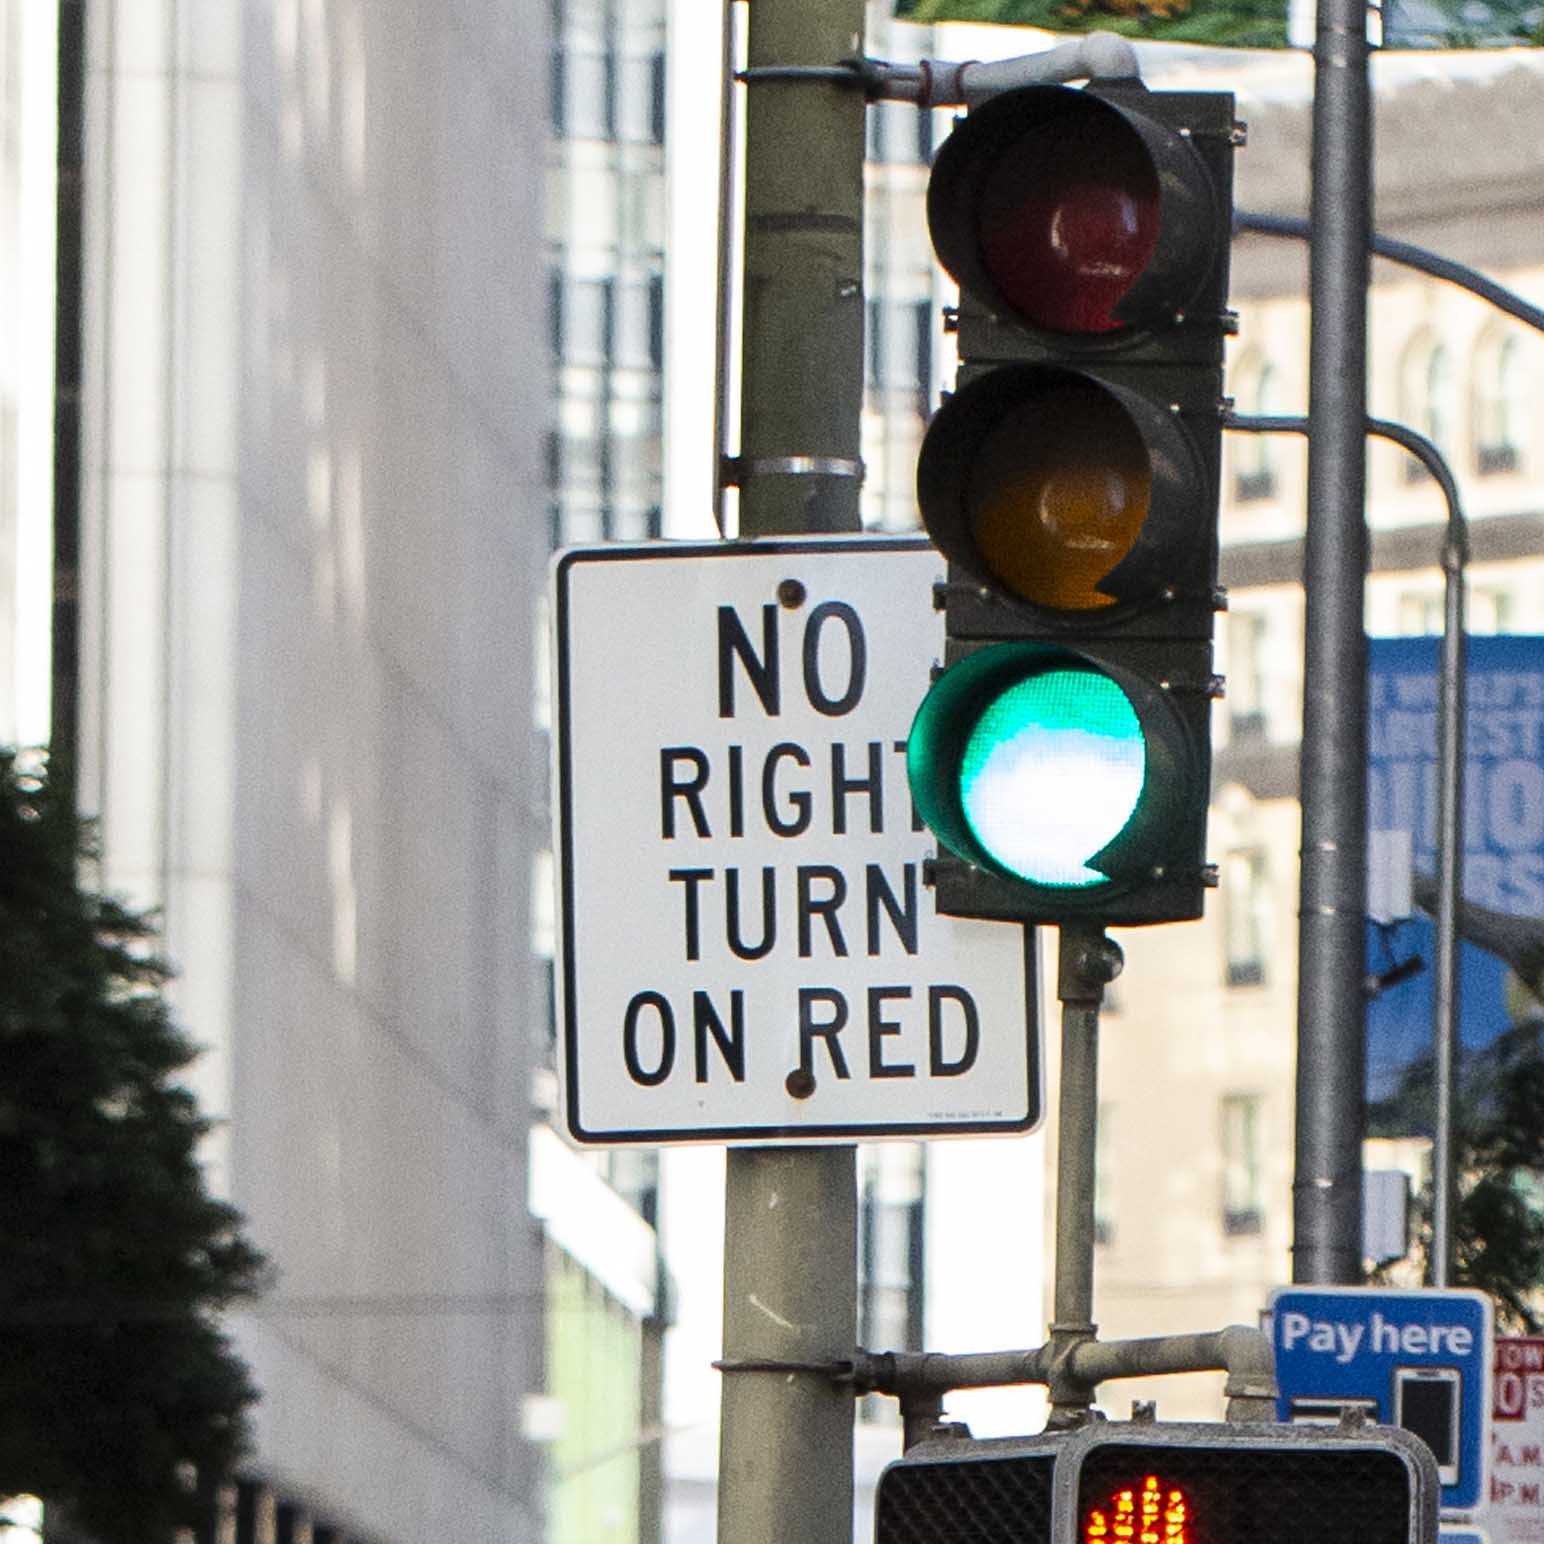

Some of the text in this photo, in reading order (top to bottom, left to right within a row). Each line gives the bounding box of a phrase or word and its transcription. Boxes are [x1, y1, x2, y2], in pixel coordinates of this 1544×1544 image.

[716, 600, 867, 718] NO
[668, 862, 919, 961] TURN
[623, 984, 981, 1087] ON RED
[1281, 1311, 1474, 1364] Pay here
